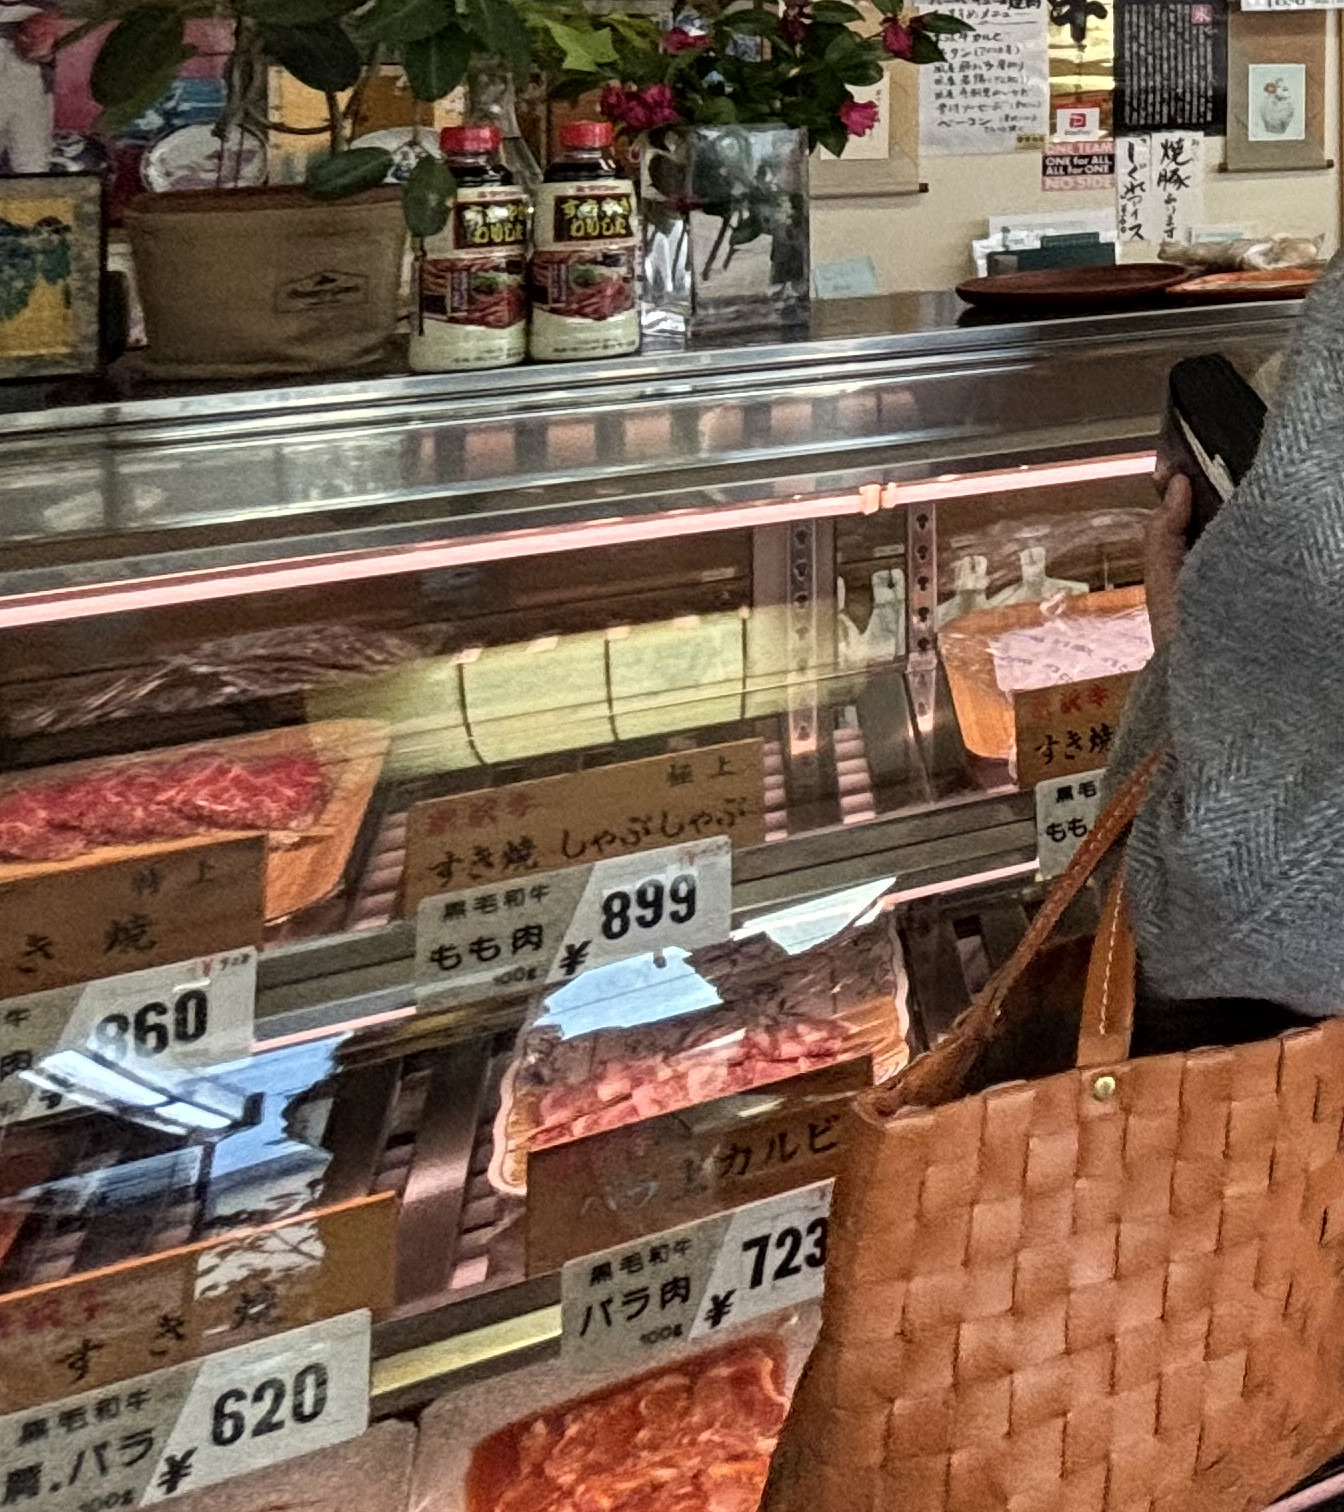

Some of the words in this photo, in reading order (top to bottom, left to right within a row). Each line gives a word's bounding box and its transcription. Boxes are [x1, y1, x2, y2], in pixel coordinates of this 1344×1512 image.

[1045, 156, 1071, 166] ONE
[1072, 155, 1090, 165] for
[1046, 165, 1066, 175] ALL
[1066, 164, 1084, 174] for
[1084, 163, 1110, 173] ONE
[1035, 722, 1115, 766] すき焼
[429, 835, 540, 887] すき焼
[561, 795, 750, 859] しゃぶしゃぶ
[1046, 817, 1089, 844] もも
[441, 883, 551, 922] 黒毛和牛
[558, 939, 593, 976] ¥
[601, 873, 697, 940] 899
[430, 924, 544, 971] もも肉
[588, 1236, 693, 1288] 黒毛和牛
[704, 1288, 738, 1330] ¥
[742, 1215, 830, 1290] 723
[578, 1275, 692, 1337] バラ肉
[156, 1446, 199, 1496] ¥
[210, 1362, 329, 1447] 620
